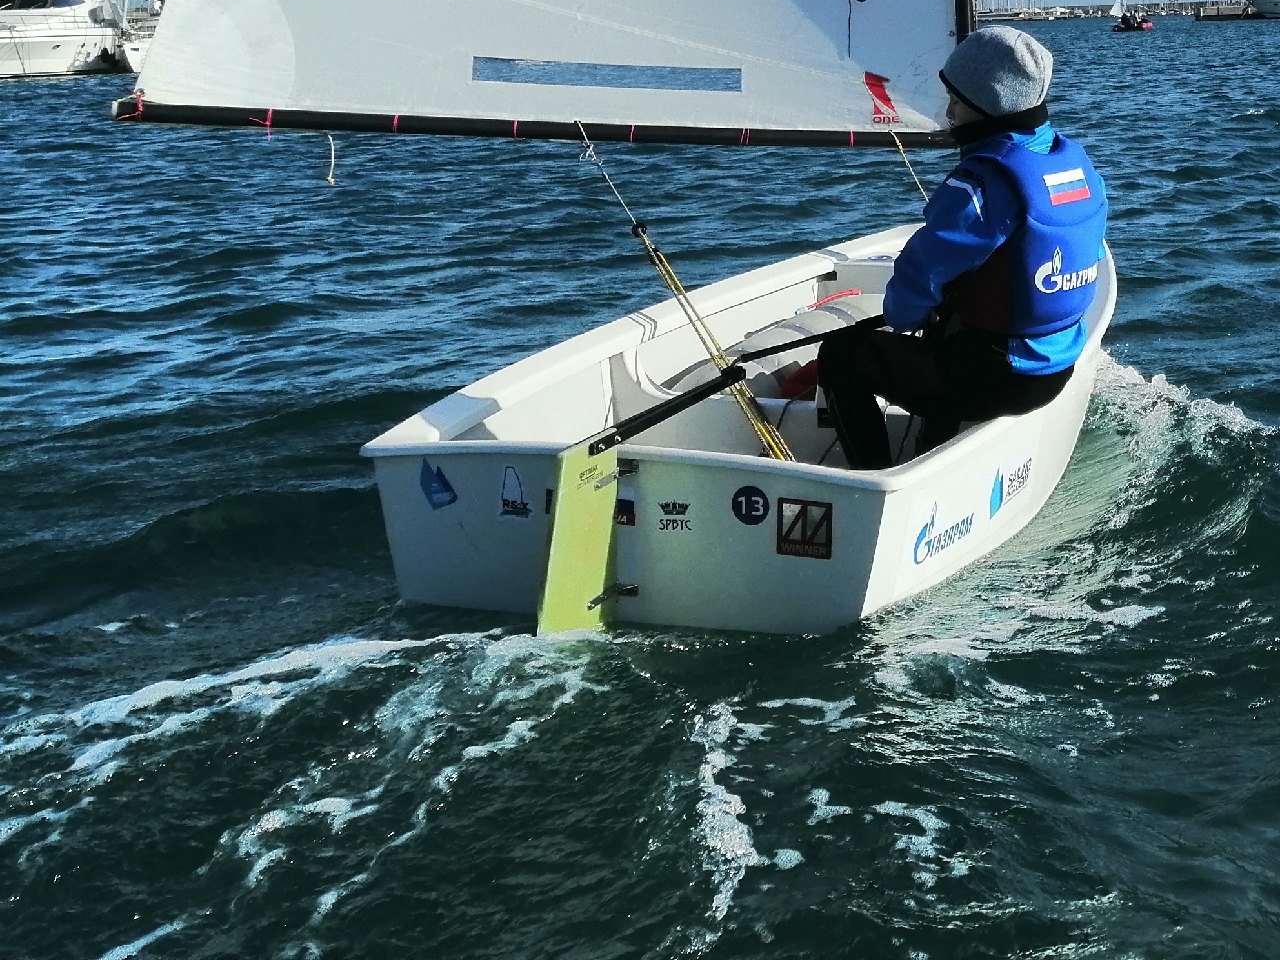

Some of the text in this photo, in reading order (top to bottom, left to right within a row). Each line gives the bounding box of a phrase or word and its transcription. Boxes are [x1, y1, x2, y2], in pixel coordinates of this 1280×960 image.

[737, 496, 764, 516] 13
[658, 518, 693, 531] SPBYC
[781, 542, 826, 556] WINNER
